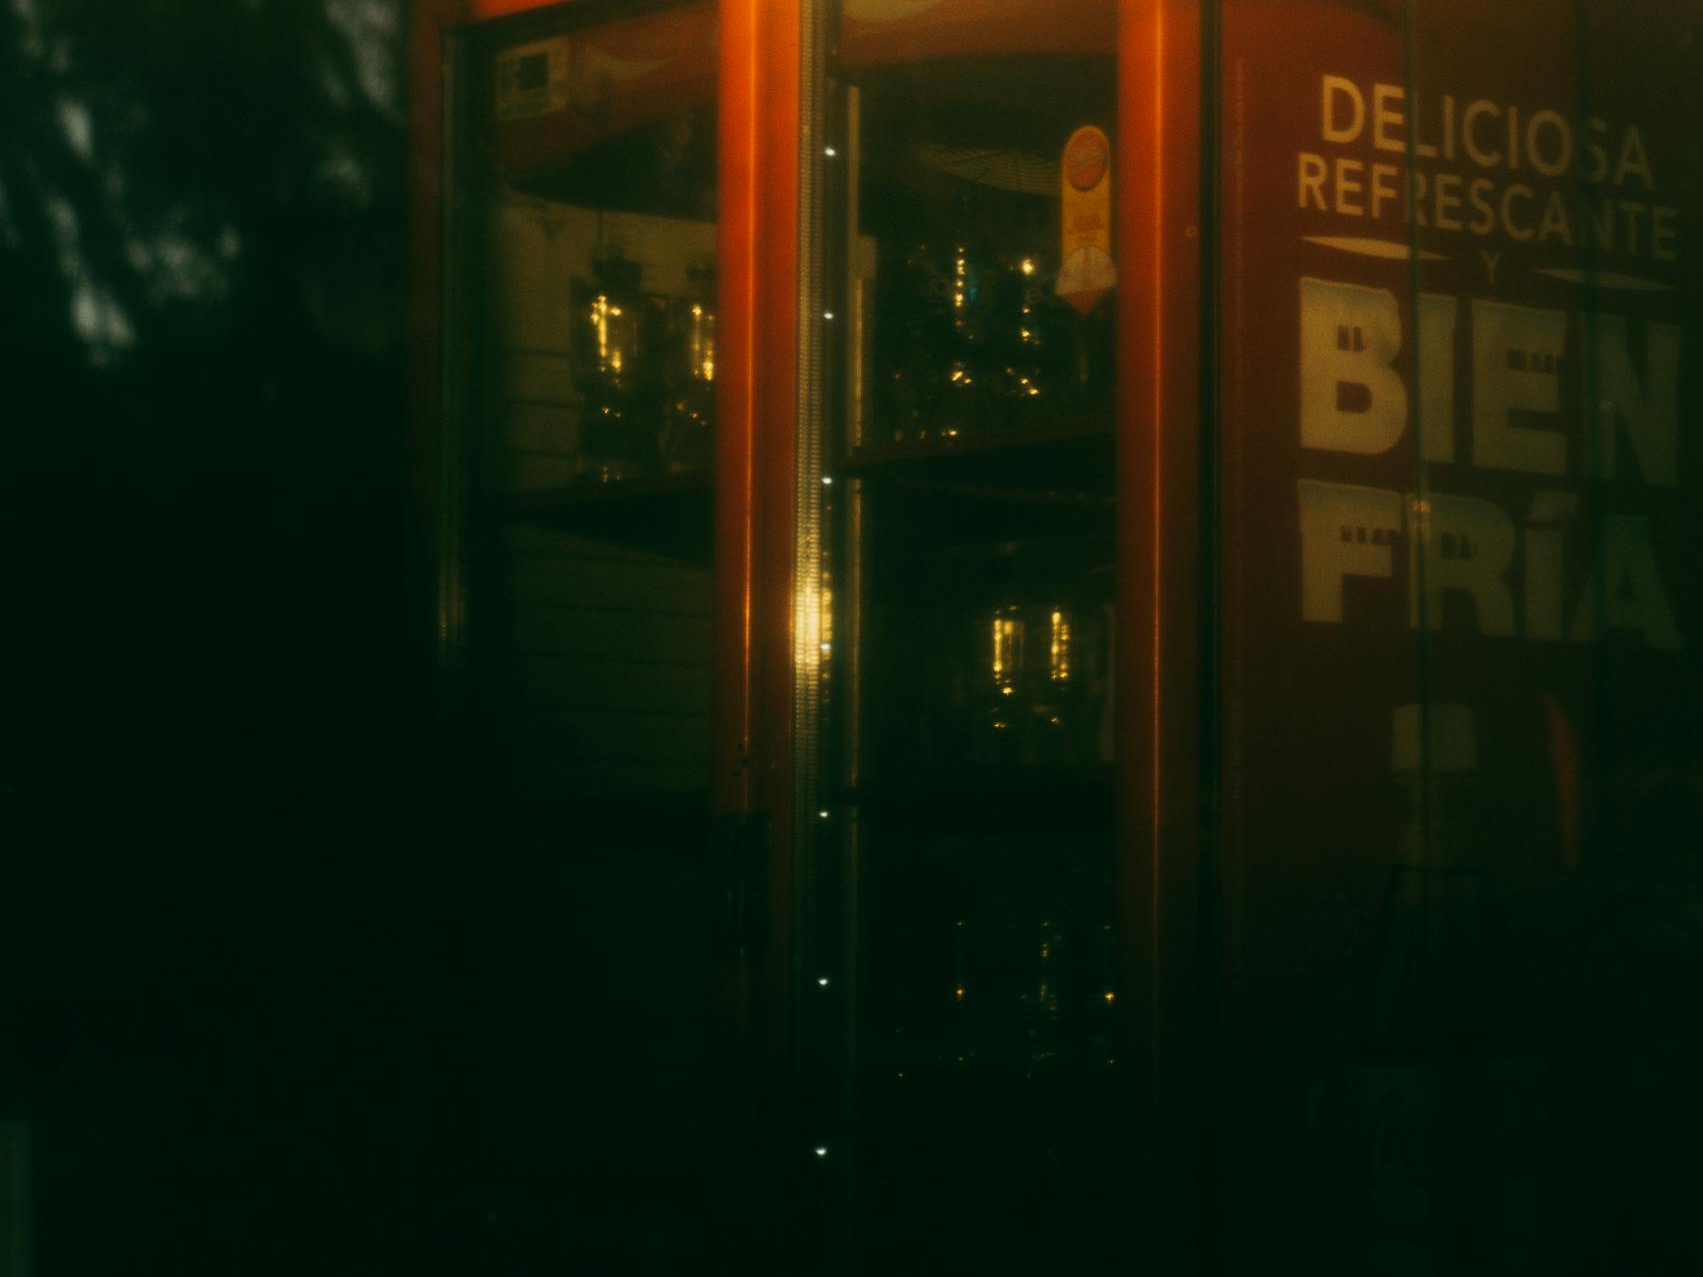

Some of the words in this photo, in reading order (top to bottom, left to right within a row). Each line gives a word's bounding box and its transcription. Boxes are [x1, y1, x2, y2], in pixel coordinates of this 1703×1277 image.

[1321, 73, 1656, 191] DELICIOSA
[1297, 151, 1678, 262] REFRESCANTE
[1481, 249, 1502, 285] Y
[1298, 275, 1682, 488] BIEN
[1298, 478, 1683, 651] FRÍA
